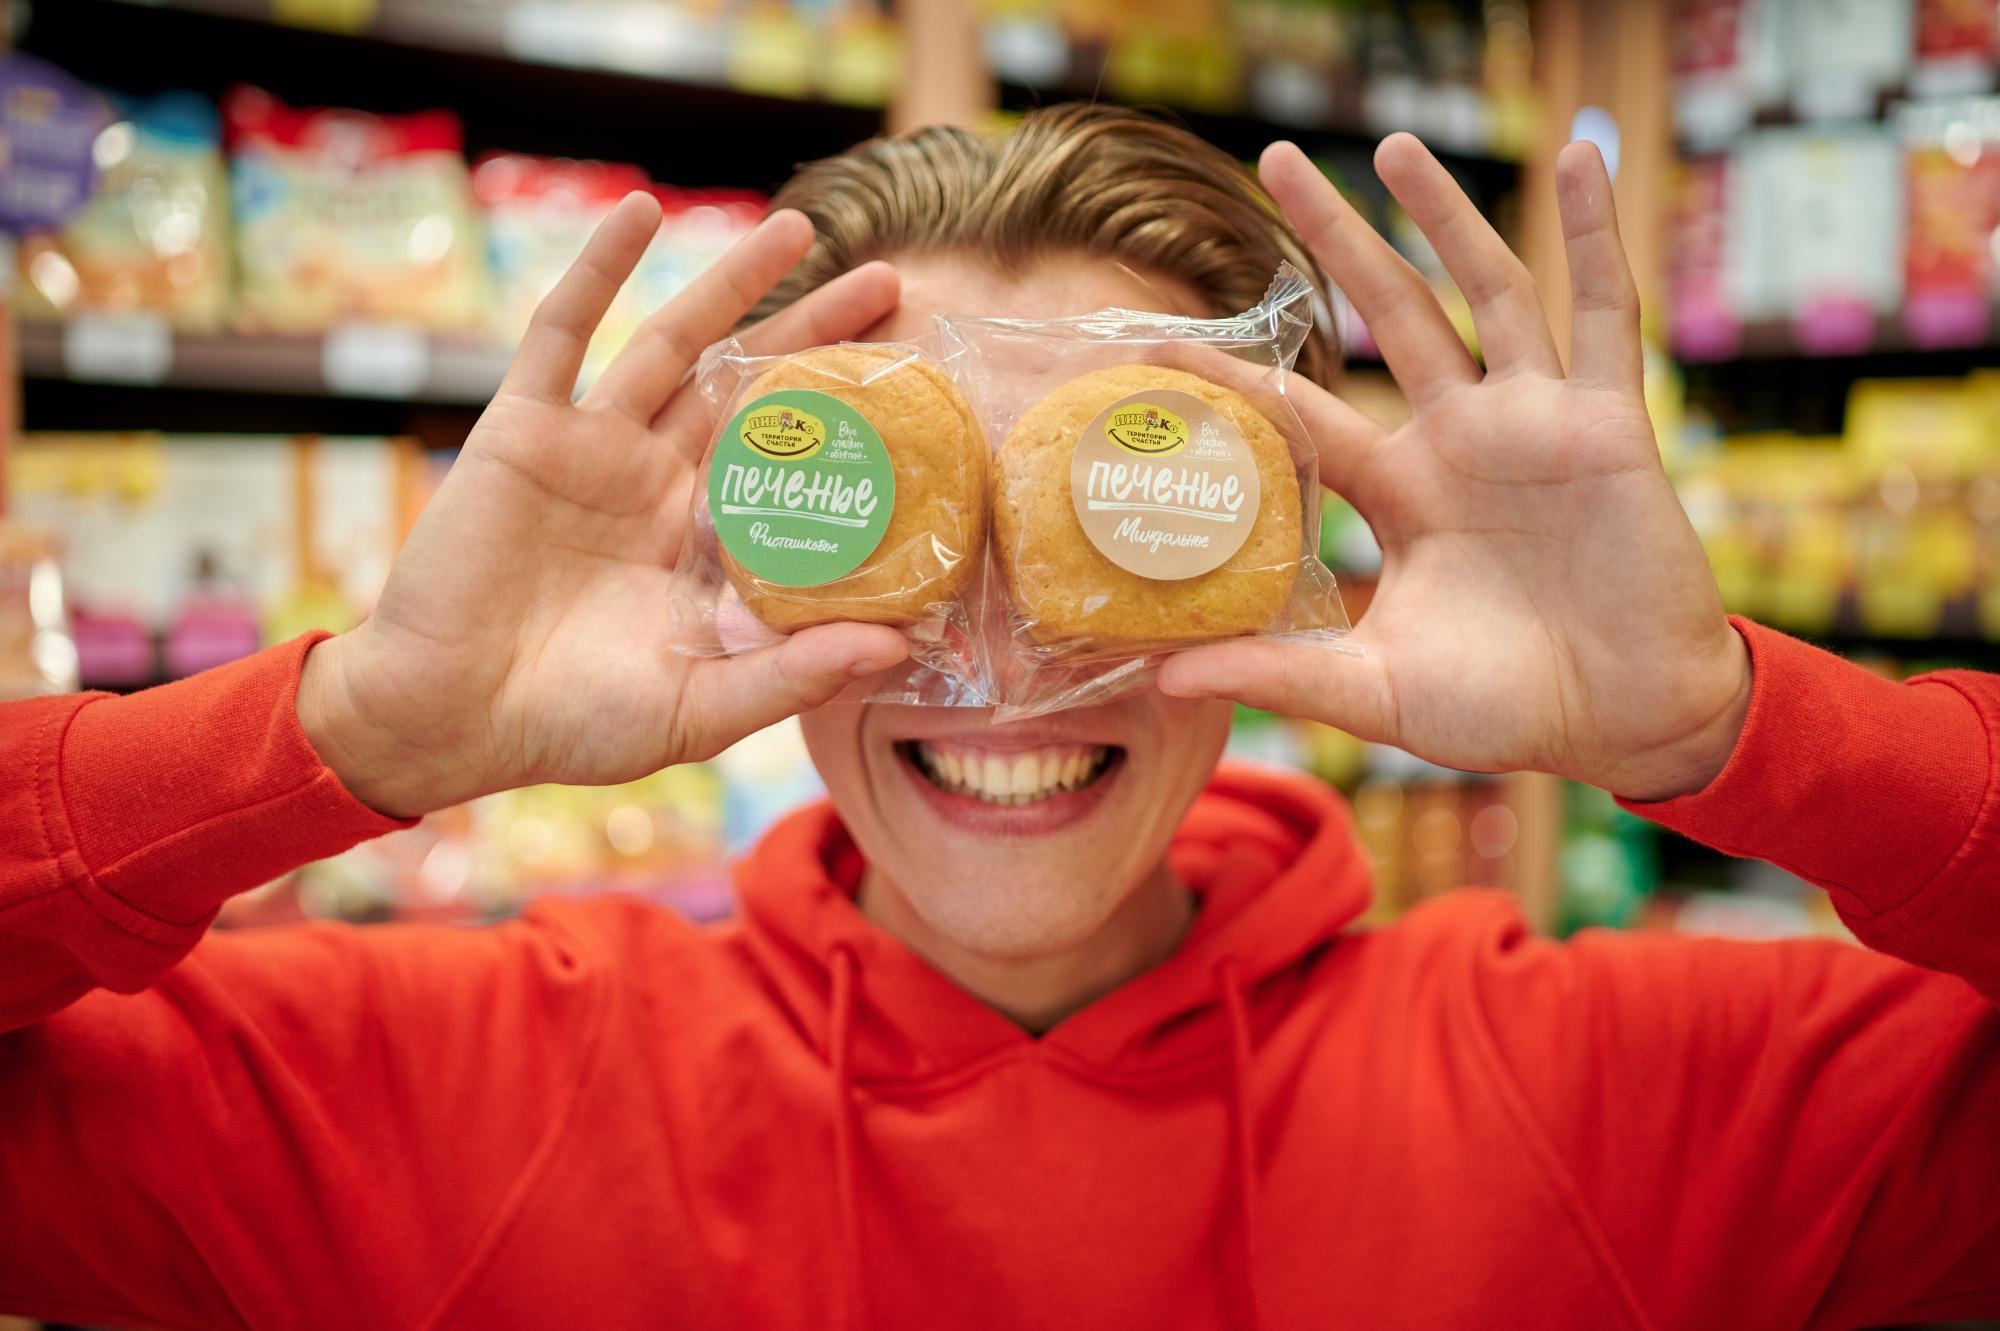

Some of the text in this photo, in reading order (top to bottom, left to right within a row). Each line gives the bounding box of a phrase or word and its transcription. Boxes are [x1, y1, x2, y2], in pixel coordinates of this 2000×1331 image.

[761, 433, 802, 443] ТЕРРИТОРИЯ
[1126, 430, 1167, 441] ТЕРРИТОРИЯ
[766, 439, 796, 448] СЧАСТЬЯ
[1131, 437, 1161, 446] СЧАСТЬЯ
[749, 521, 839, 553] Фисташковое
[1113, 516, 1210, 553] Миндальное
